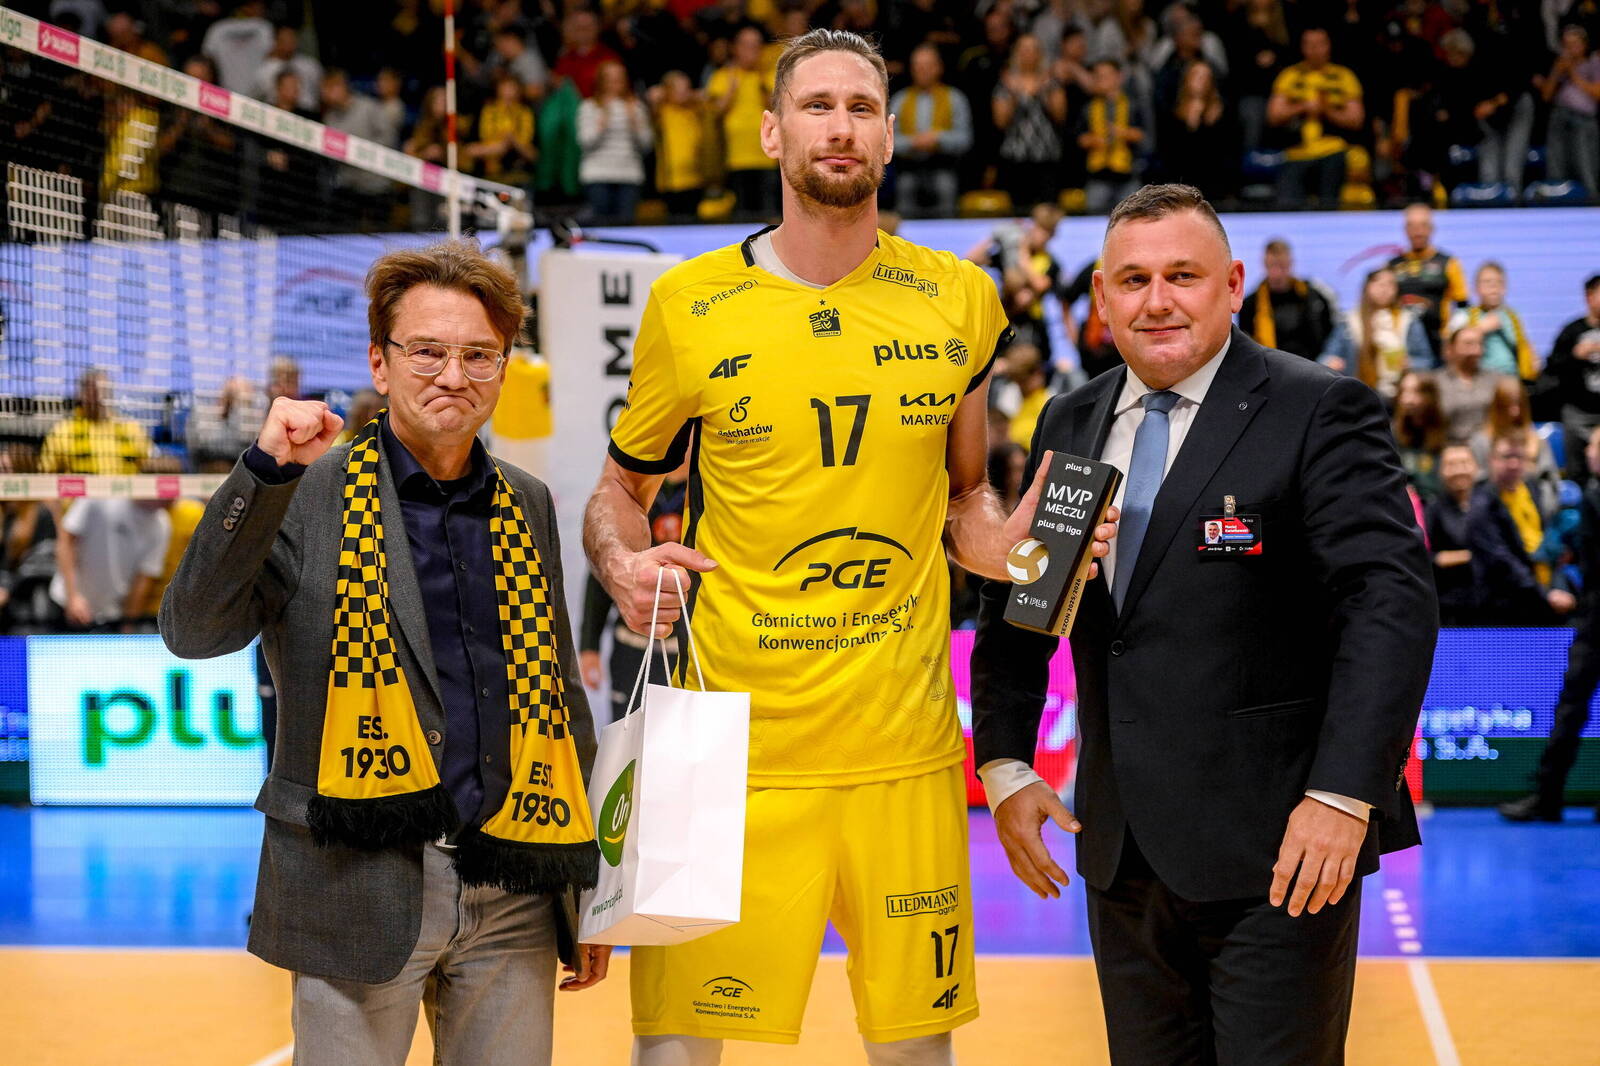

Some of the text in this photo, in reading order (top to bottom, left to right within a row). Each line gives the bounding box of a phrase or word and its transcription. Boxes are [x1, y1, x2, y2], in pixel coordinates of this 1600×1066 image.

[808, 307, 841, 323] SKRA
[873, 340, 939, 366] plus
[709, 354, 752, 379] 4F
[810, 394, 871, 467] 17
[1065, 462, 1082, 472] plus
[1046, 482, 1093, 506] MVP
[1044, 502, 1086, 520] MECZU
[1037, 519, 1082, 536] plus liga
[799, 558, 892, 591] PGE
[752, 611, 837, 628] Górnictwo
[842, 612, 847, 627] i
[1060, 612, 1071, 636] SEZON
[341, 745, 411, 780] 1930
[511, 791, 570, 828] 1930
[890, 890, 956, 913] LIEDMANN
[931, 924, 959, 978] 17
[711, 986, 743, 997] PGE
[932, 983, 959, 1009] 4F
[693, 1000, 723, 1009] Górnictwo
[727, 1003, 760, 1013] Energetyka
